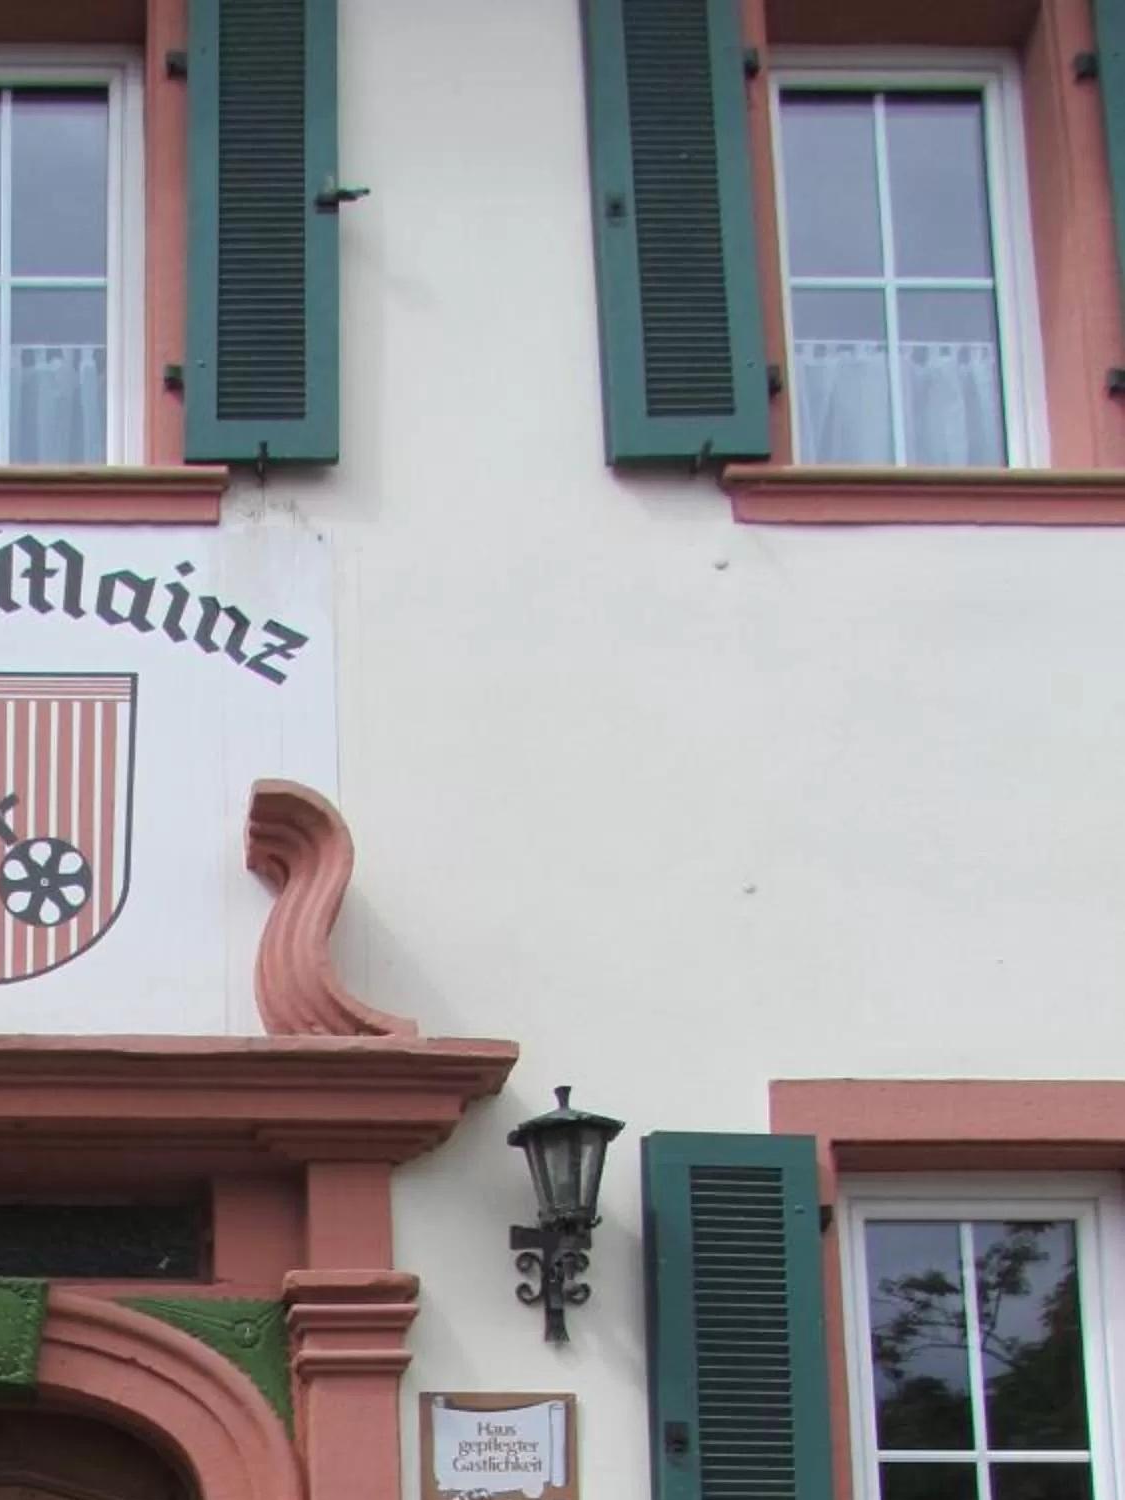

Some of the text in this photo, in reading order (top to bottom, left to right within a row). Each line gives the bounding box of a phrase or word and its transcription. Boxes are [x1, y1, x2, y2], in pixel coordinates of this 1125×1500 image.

[477, 1422, 517, 1437] Haus
[458, 1440, 539, 1456] gepflegter
[452, 1456, 543, 1473] Gastlichkeit
